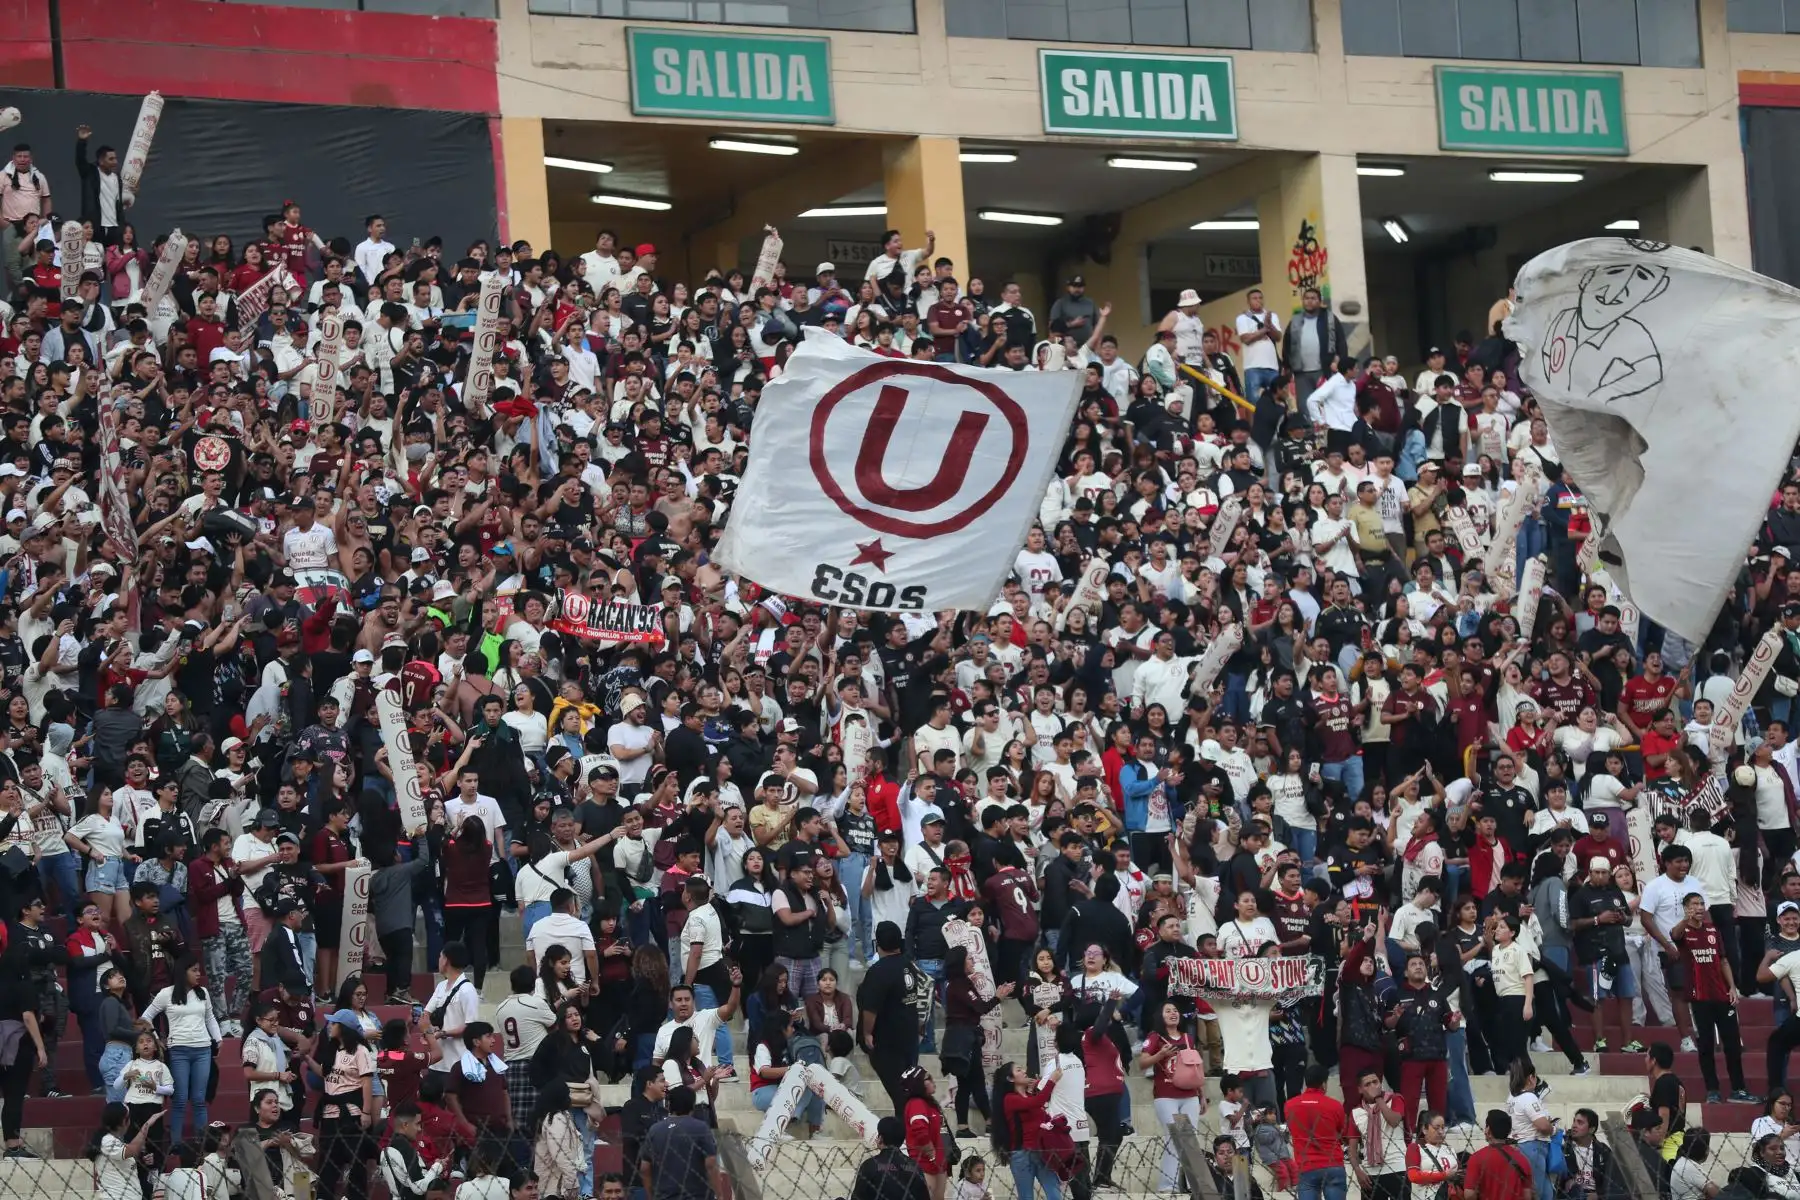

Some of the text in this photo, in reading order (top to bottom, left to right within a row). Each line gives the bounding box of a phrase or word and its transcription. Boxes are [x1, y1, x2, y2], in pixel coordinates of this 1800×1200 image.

[652, 47, 814, 102] SALIDA
[1061, 68, 1217, 122] SALIDA
[1459, 85, 1609, 135] SALIDA
[855, 385, 990, 512] U
[811, 563, 928, 609] ESOS
[406, 681, 416, 705] 9
[1554, 698, 1580, 706] apuesta
[1332, 723, 1347, 732] total
[1592, 813, 1606, 822] 100
[848, 829, 875, 840] apuesta
[854, 837, 871, 846] total
[1013, 887, 1028, 913] 9
[1281, 917, 1309, 926] apuesta
[1287, 924, 1304, 932] total
[1695, 955, 1713, 963] total
[1177, 958, 1206, 987] RICO
[1208, 959, 1235, 989] PAIT
[1271, 958, 1307, 989] STONE
[504, 1017, 520, 1049] 9
